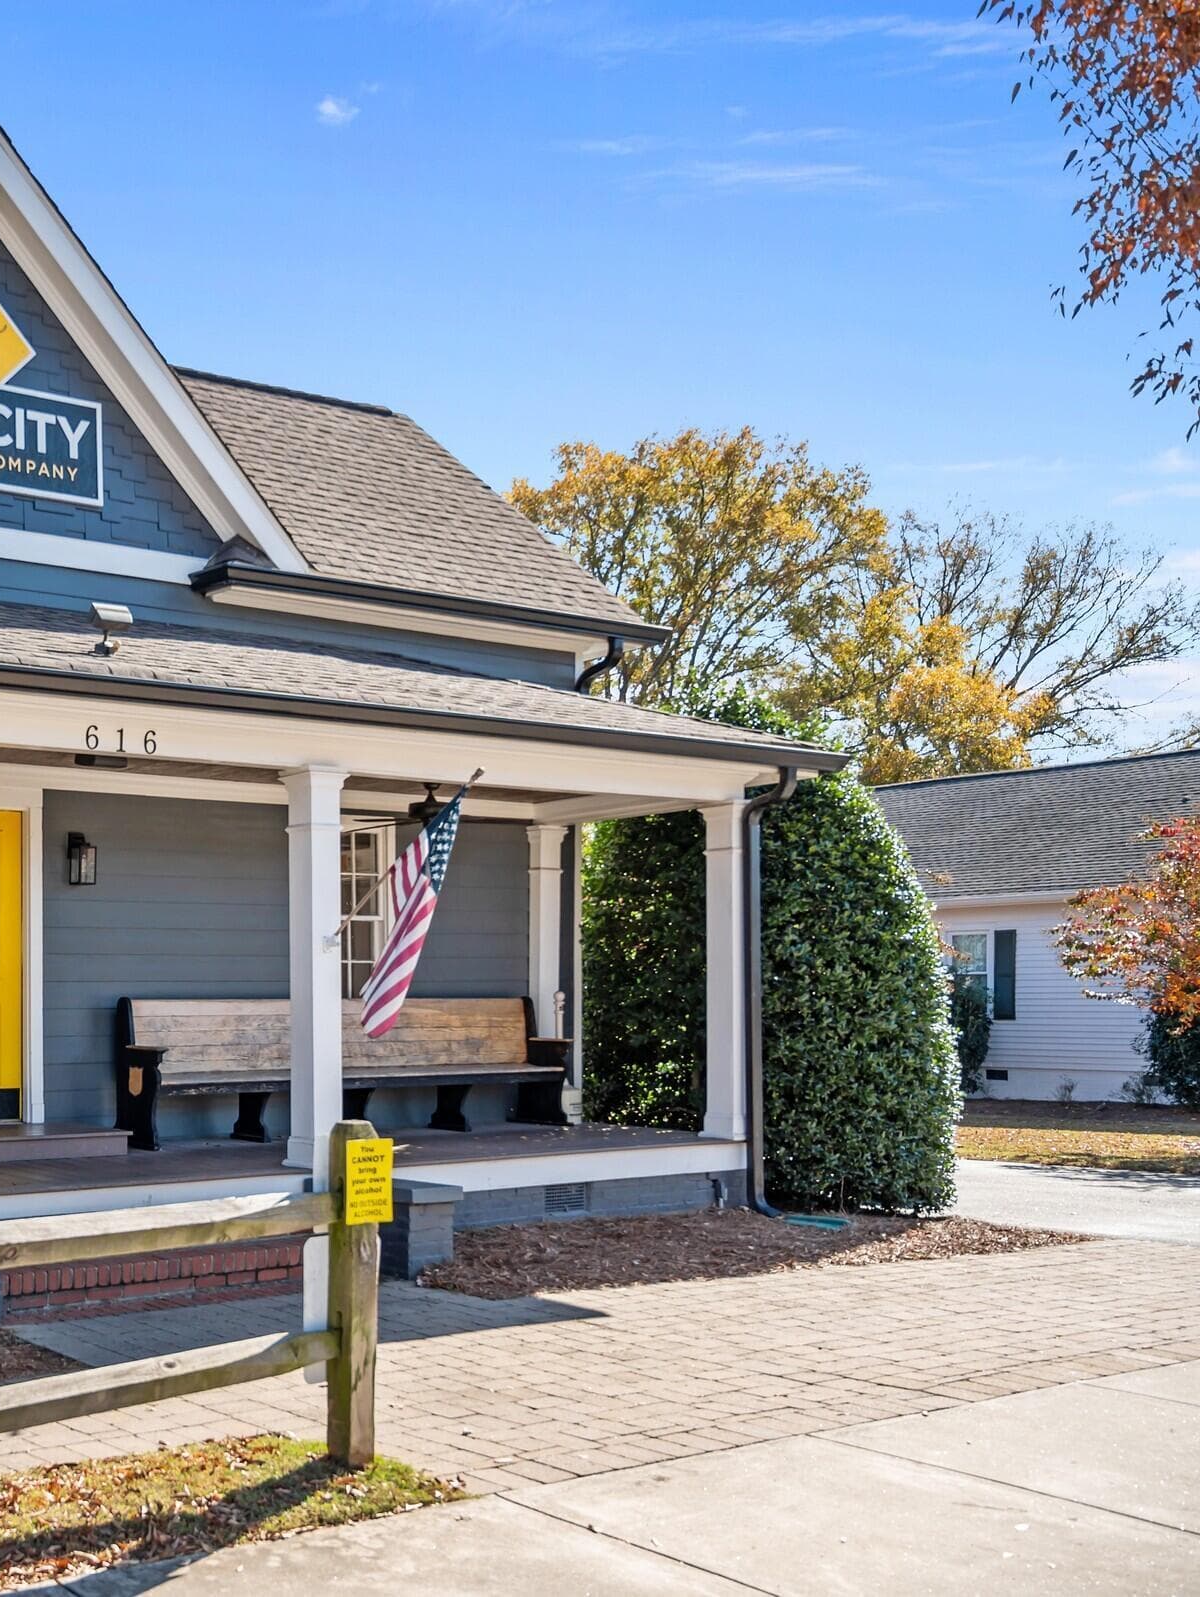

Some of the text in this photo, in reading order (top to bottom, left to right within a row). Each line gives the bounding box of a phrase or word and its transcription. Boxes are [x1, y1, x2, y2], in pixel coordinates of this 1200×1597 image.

[85, 725, 157, 754] 616
[352, 1155, 385, 1164] CANNOT
[355, 1187, 382, 1195] alcohol
